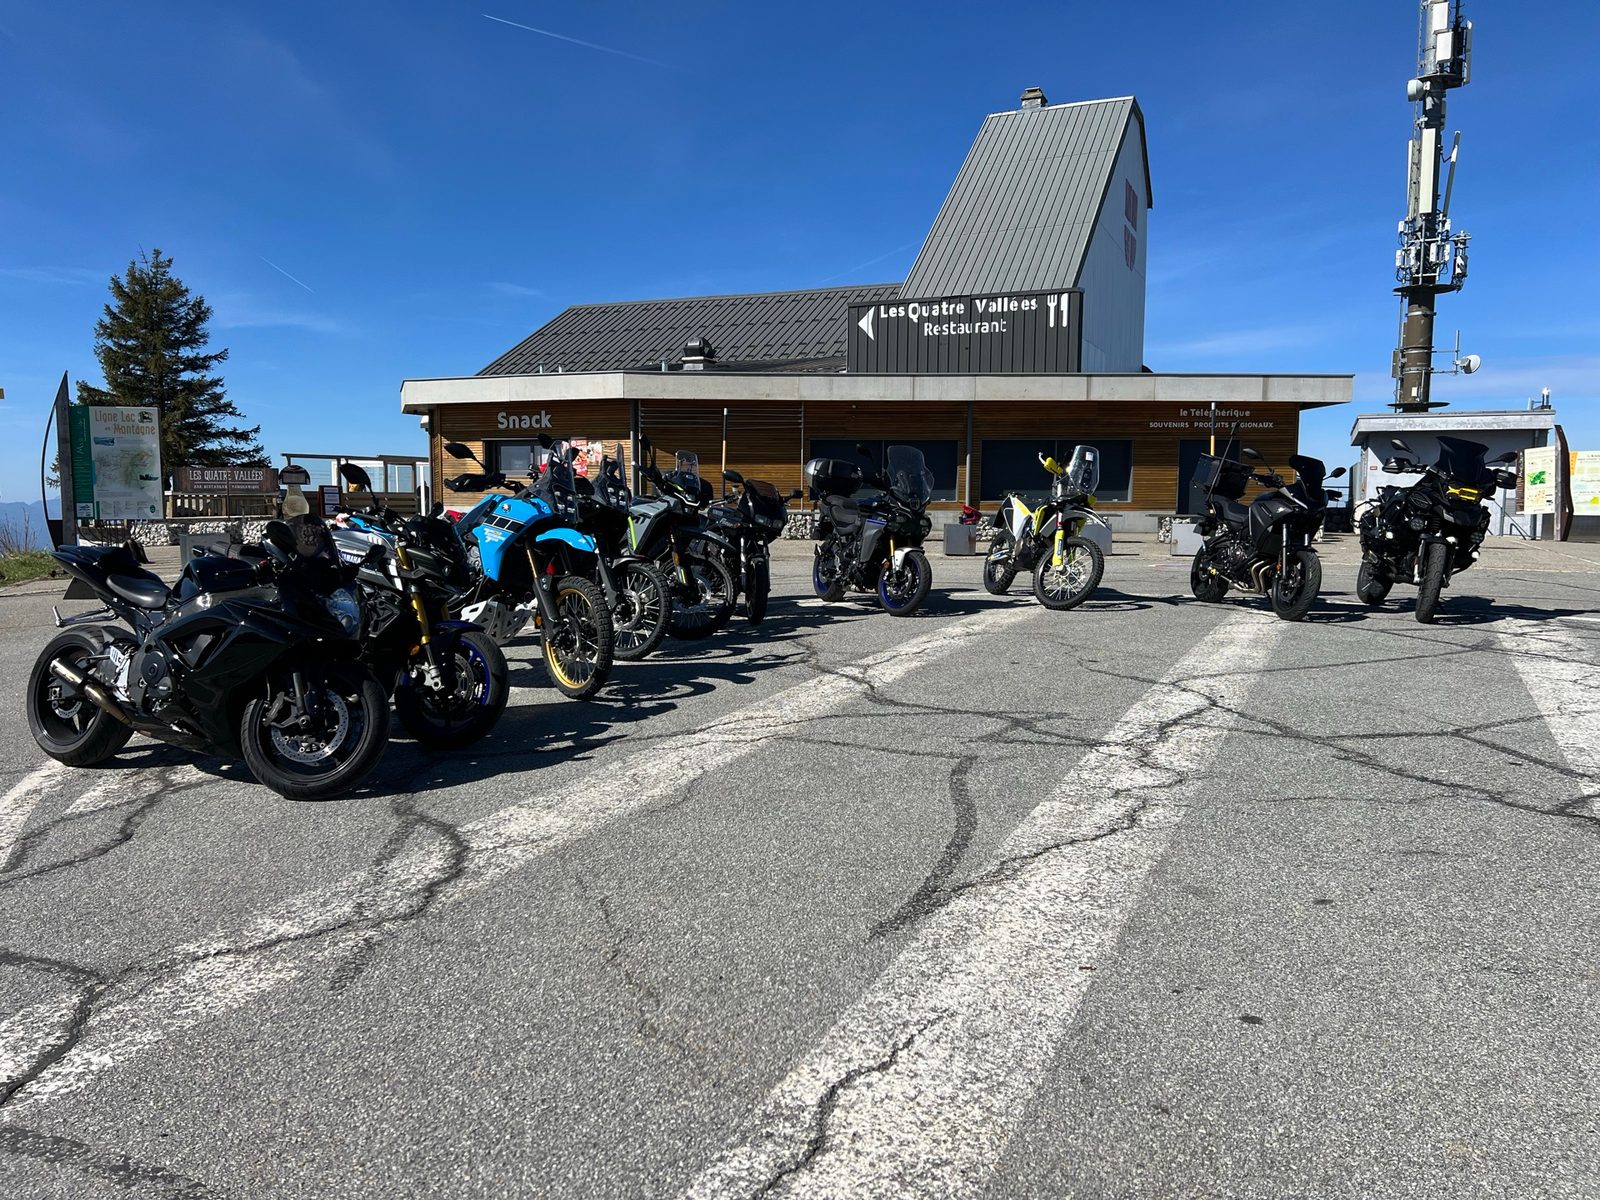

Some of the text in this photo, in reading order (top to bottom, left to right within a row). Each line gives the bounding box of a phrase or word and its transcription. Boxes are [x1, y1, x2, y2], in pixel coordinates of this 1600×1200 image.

[880, 296, 1038, 323] Les Quatre Vallées
[924, 318, 1007, 336] Restaurant
[121, 410, 136, 422] Lac
[497, 410, 552, 429] Snack
[113, 423, 155, 435] Montagne
[189, 470, 202, 480] LES
[234, 469, 263, 480] VALLÉES
